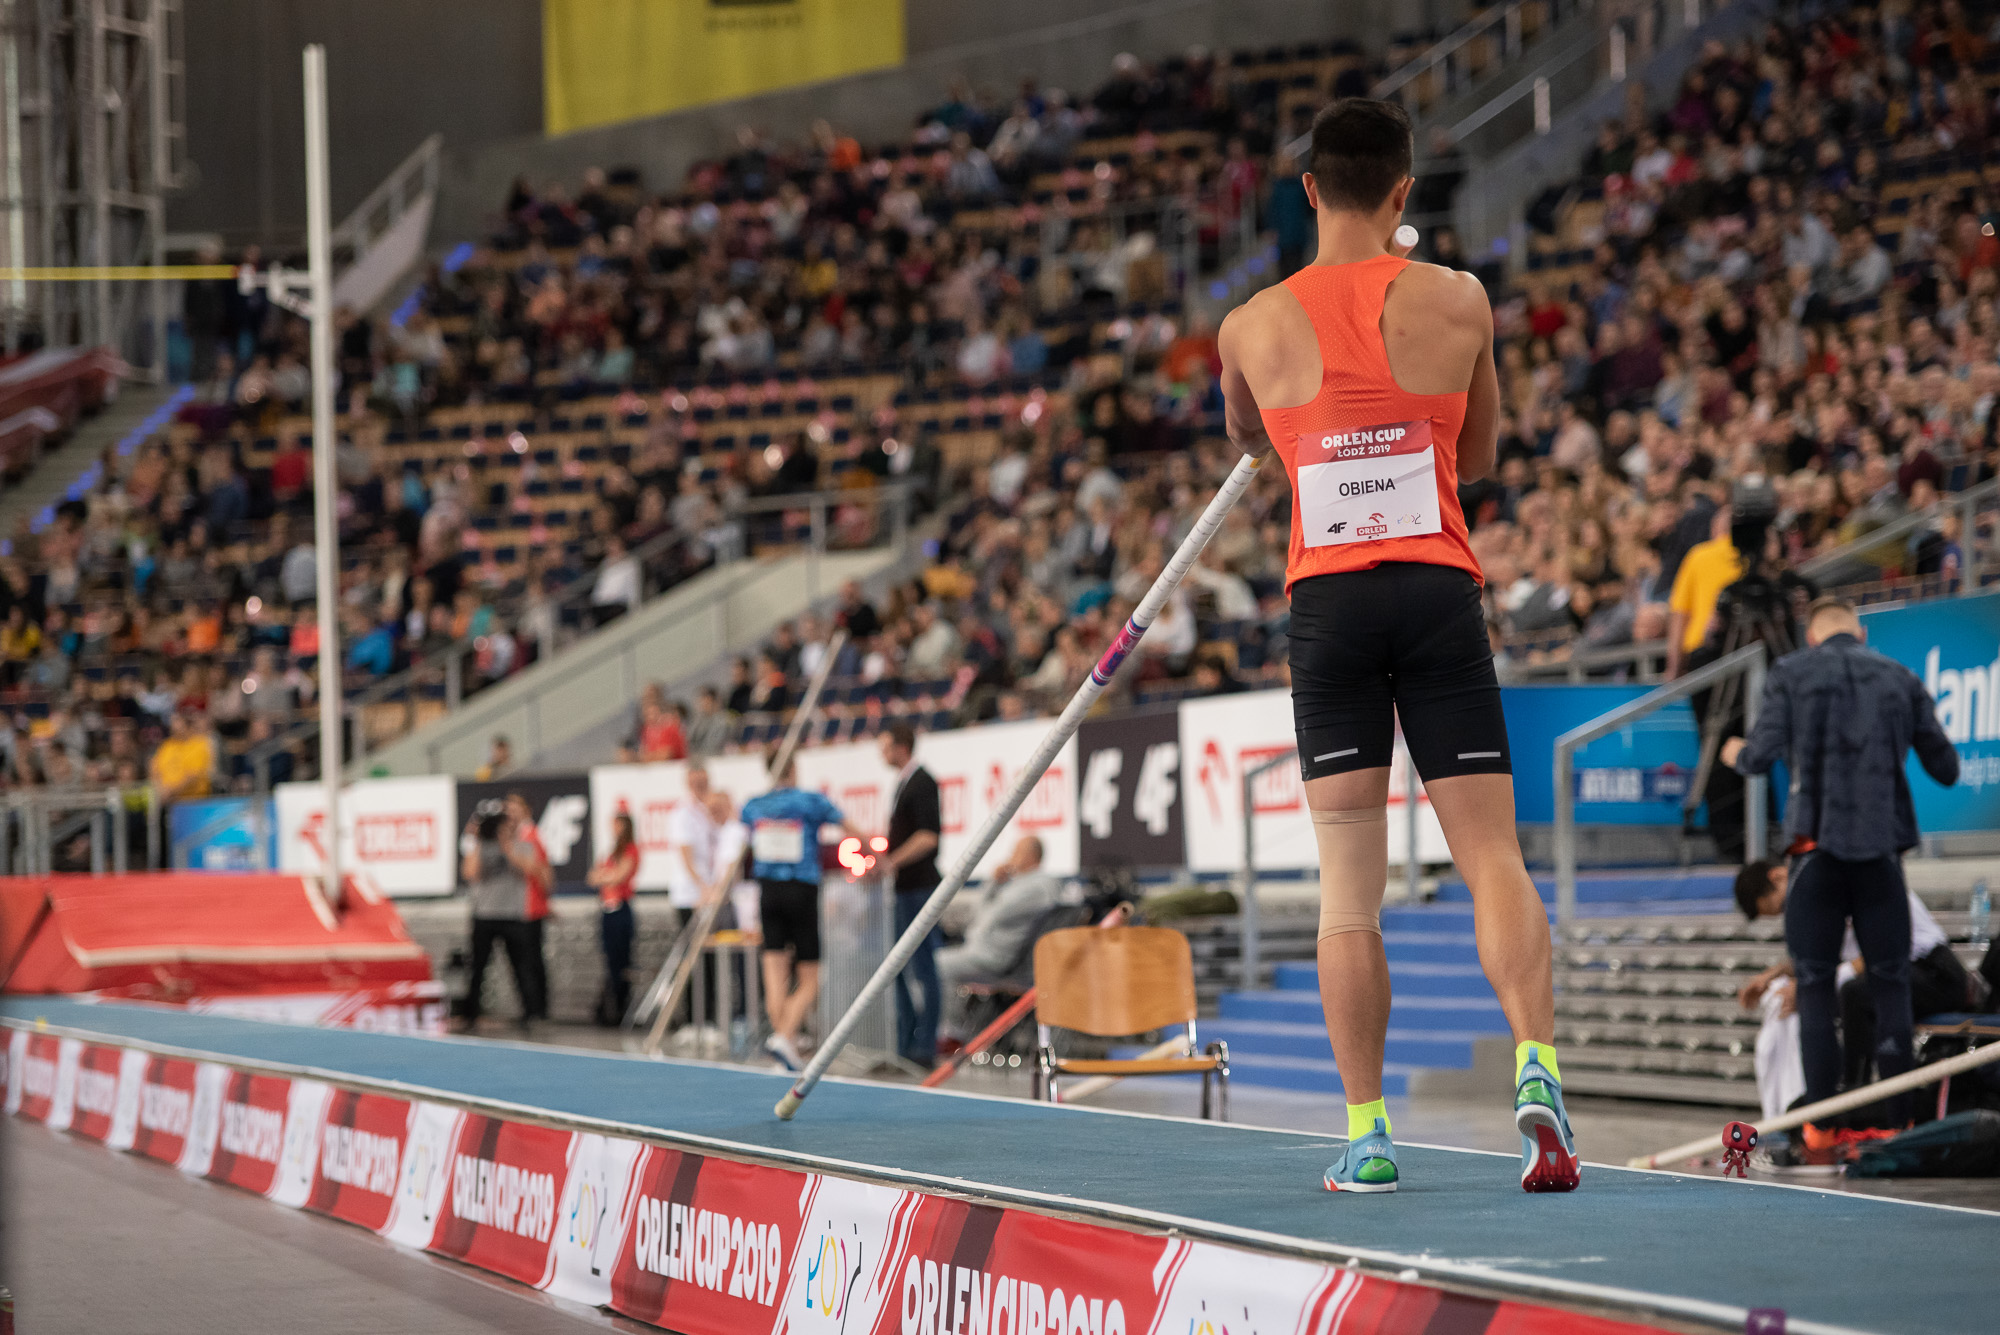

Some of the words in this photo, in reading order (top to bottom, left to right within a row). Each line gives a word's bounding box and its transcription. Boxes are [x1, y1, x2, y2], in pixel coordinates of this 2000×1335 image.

[1321, 430, 1374, 449] ORLEN
[1375, 427, 1406, 443] CUP
[1337, 445, 1366, 458] ŁÓDŹ
[1368, 444, 1391, 455] 2019
[1339, 478, 1396, 497] OBIENA
[1327, 521, 1347, 534] 4F
[1358, 525, 1386, 535] ORLEN
[1525, 1066, 1547, 1078] nike
[1366, 1143, 1387, 1155] nike
[453, 1153, 496, 1227] ORLEN
[494, 1162, 520, 1233] CUP
[516, 1168, 555, 1244] 2019
[635, 1194, 696, 1284] ORLEN
[694, 1208, 731, 1293] CUP
[727, 1216, 782, 1308] 2019
[902, 1254, 991, 1335] ORLEN
[992, 1274, 1046, 1335] CUP
